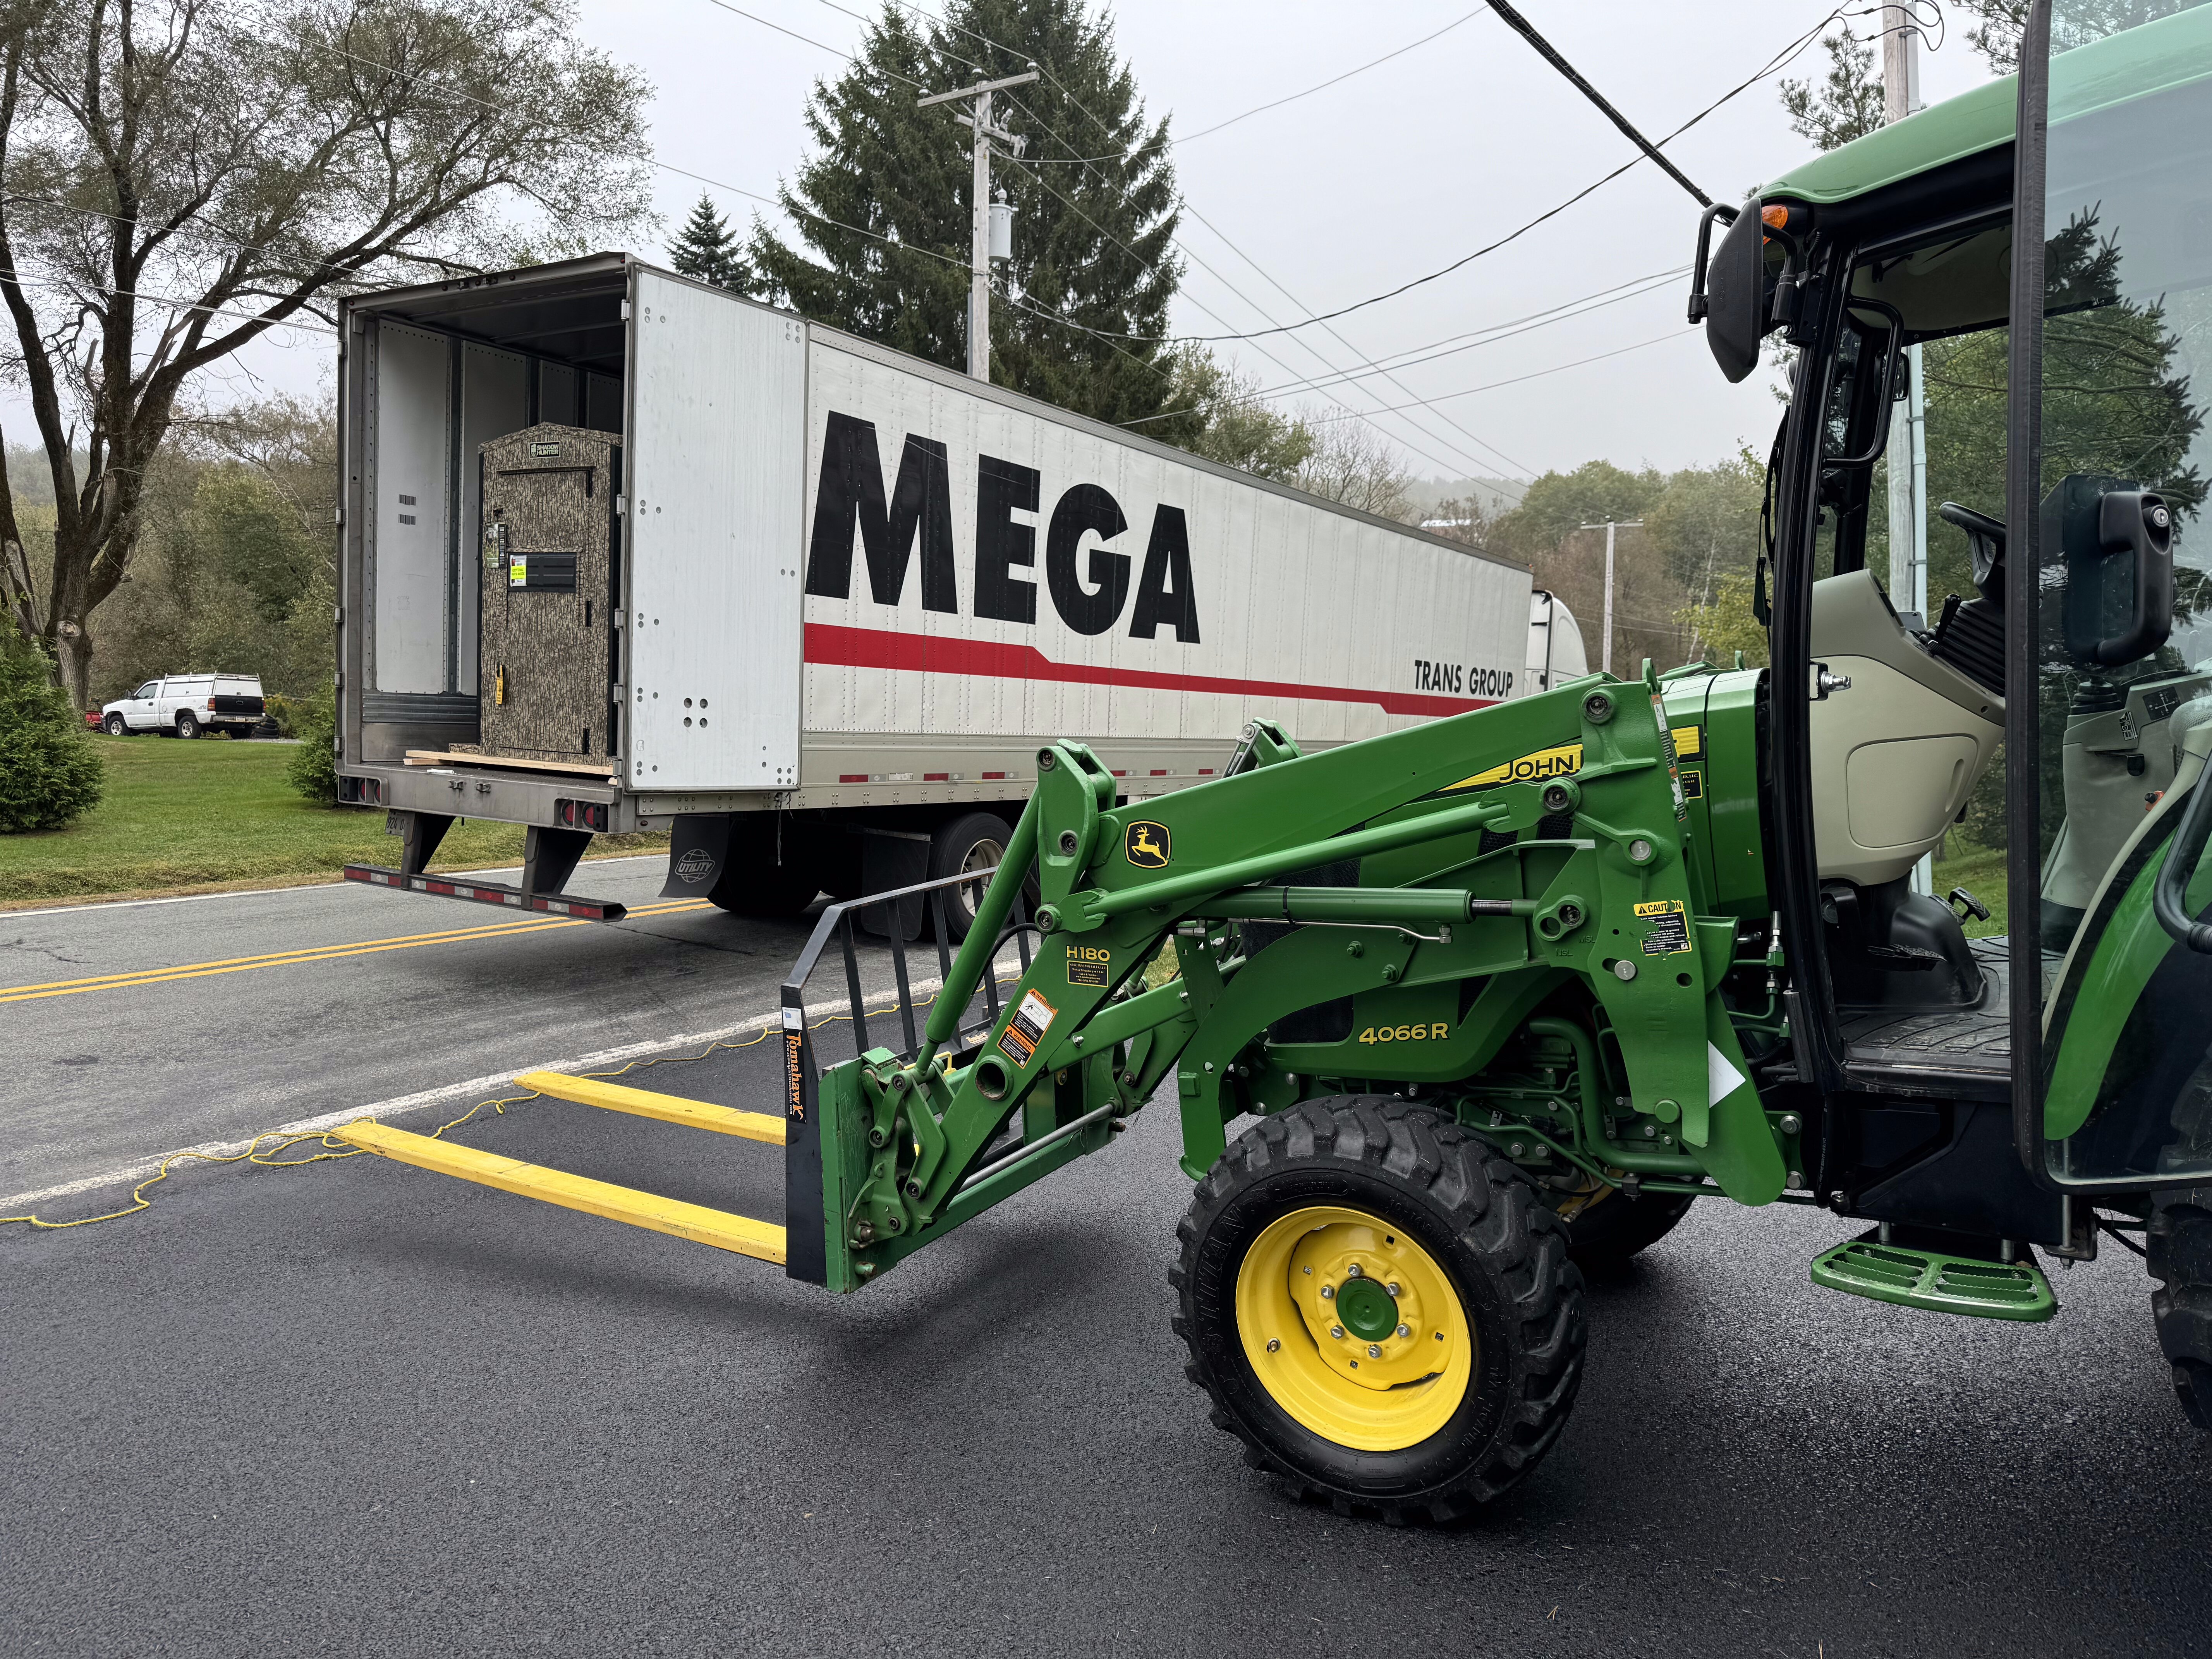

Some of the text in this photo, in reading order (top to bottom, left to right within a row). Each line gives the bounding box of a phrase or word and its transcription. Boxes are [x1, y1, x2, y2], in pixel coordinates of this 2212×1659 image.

[805, 410, 1200, 644] MEGA
[1415, 660, 1513, 697] TRANS GROUP
[1500, 754, 1575, 781] JOHN
[387, 817, 405, 830] 924 0
[678, 862, 713, 873] UTILITY
[1648, 902, 1681, 913] CAUTN
[1066, 945, 1110, 962] H180
[1555, 948, 1574, 957] NSL
[1013, 1032, 1031, 1050] WARNING
[786, 1032, 804, 1120] Tomahawk
[1196, 1204, 1243, 1323] TITAN
